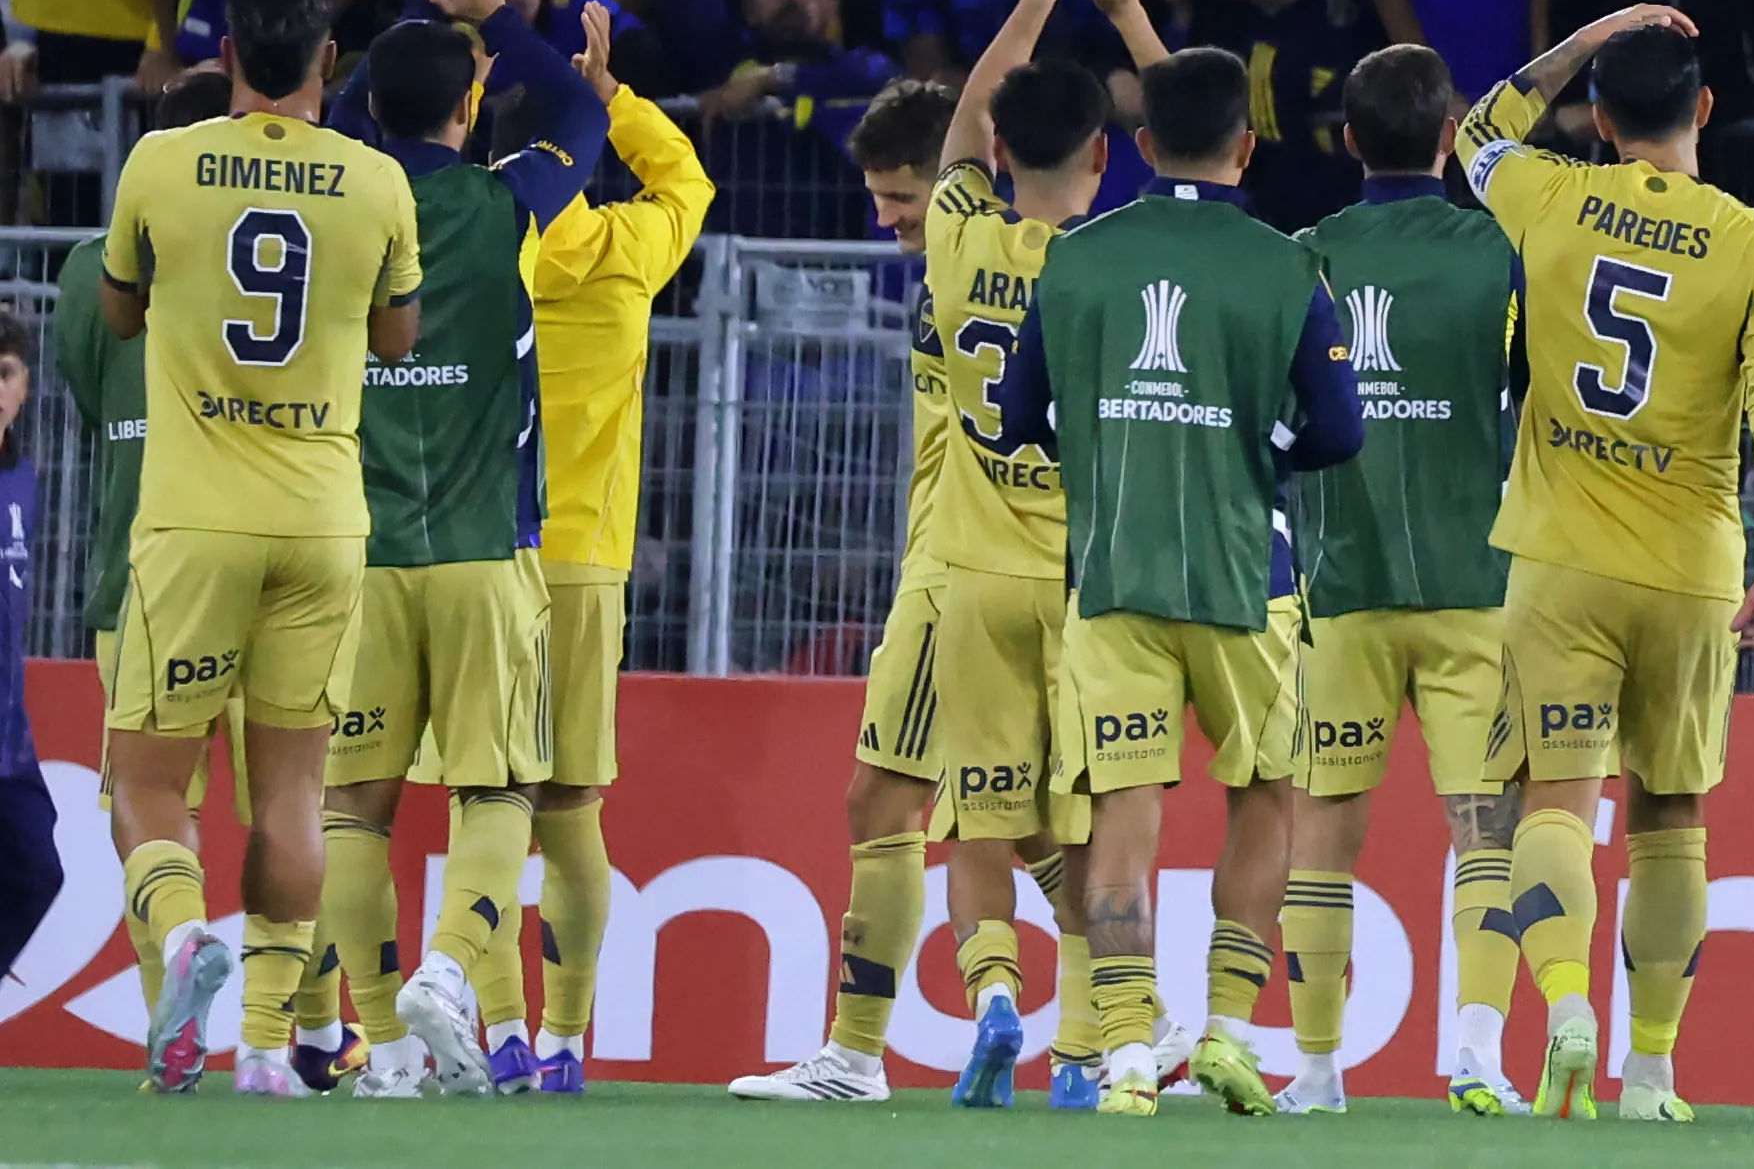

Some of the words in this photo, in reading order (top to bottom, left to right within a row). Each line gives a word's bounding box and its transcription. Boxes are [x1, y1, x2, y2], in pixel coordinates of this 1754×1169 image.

[197, 152, 345, 197] GIMENEZ
[1577, 195, 1710, 259] PAREDES
[222, 206, 312, 367] 9
[1573, 255, 1673, 420] 5
[362, 364, 469, 386] RTADORES
[198, 390, 330, 429] DIRECTV
[1098, 398, 1233, 428] BERTADORES
[1549, 417, 1674, 473] DIRECTV
[167, 649, 240, 691] pax
[1095, 708, 1169, 749] pax
[1313, 717, 1386, 748] pax
[1540, 702, 1612, 738] pax
[960, 761, 1033, 799] pax
